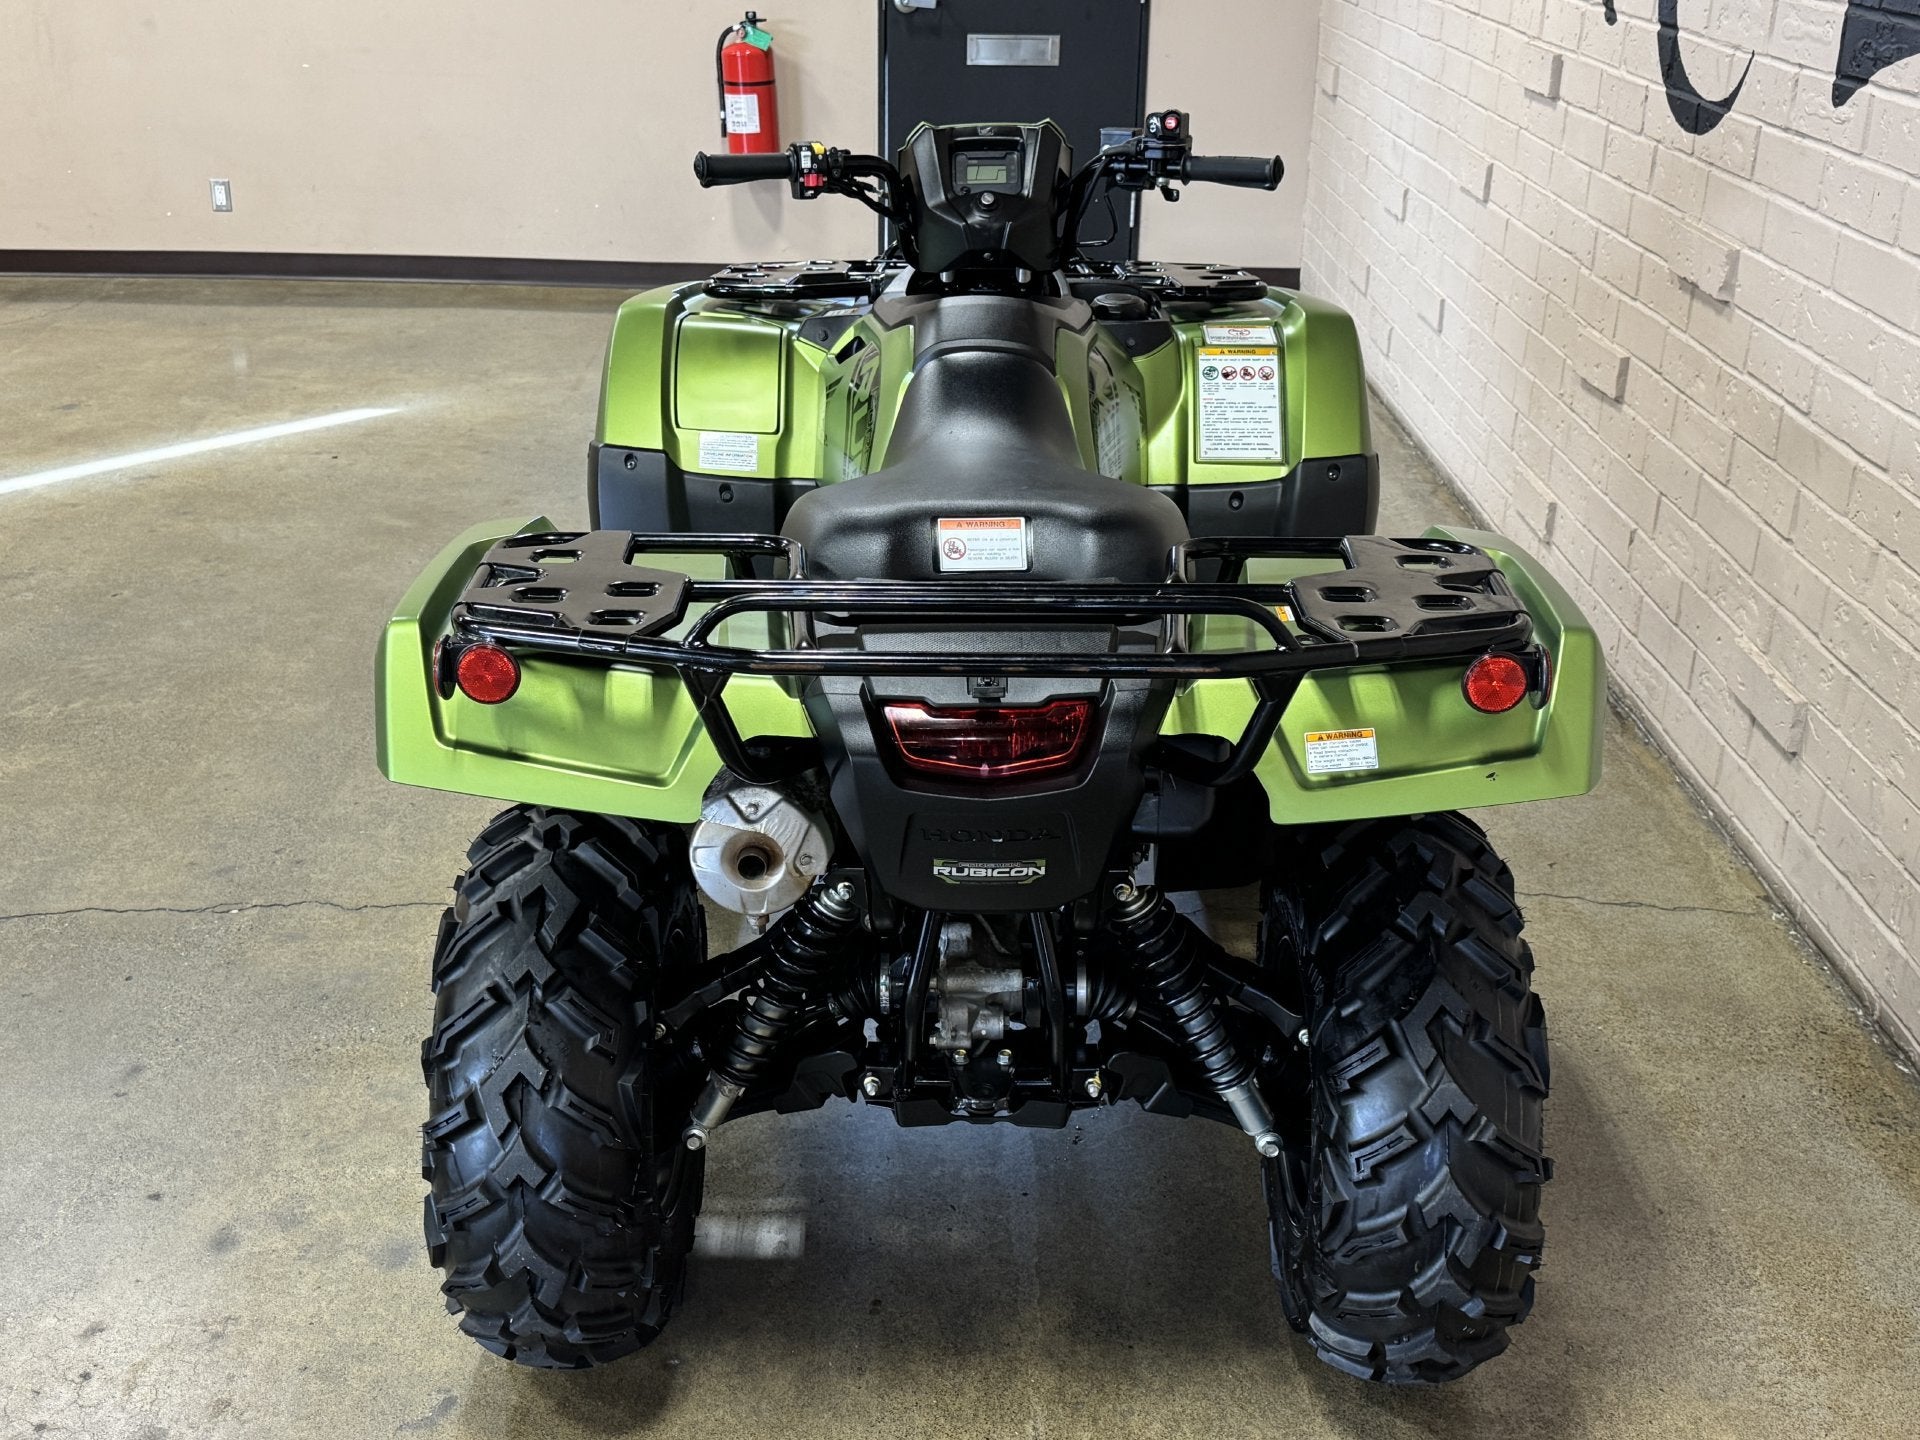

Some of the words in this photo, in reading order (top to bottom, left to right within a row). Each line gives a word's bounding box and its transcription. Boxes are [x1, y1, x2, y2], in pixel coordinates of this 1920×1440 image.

[1325, 730, 1363, 740] WARNING
[920, 827, 1062, 843] HONDA
[933, 866, 1046, 877] RUBICON
